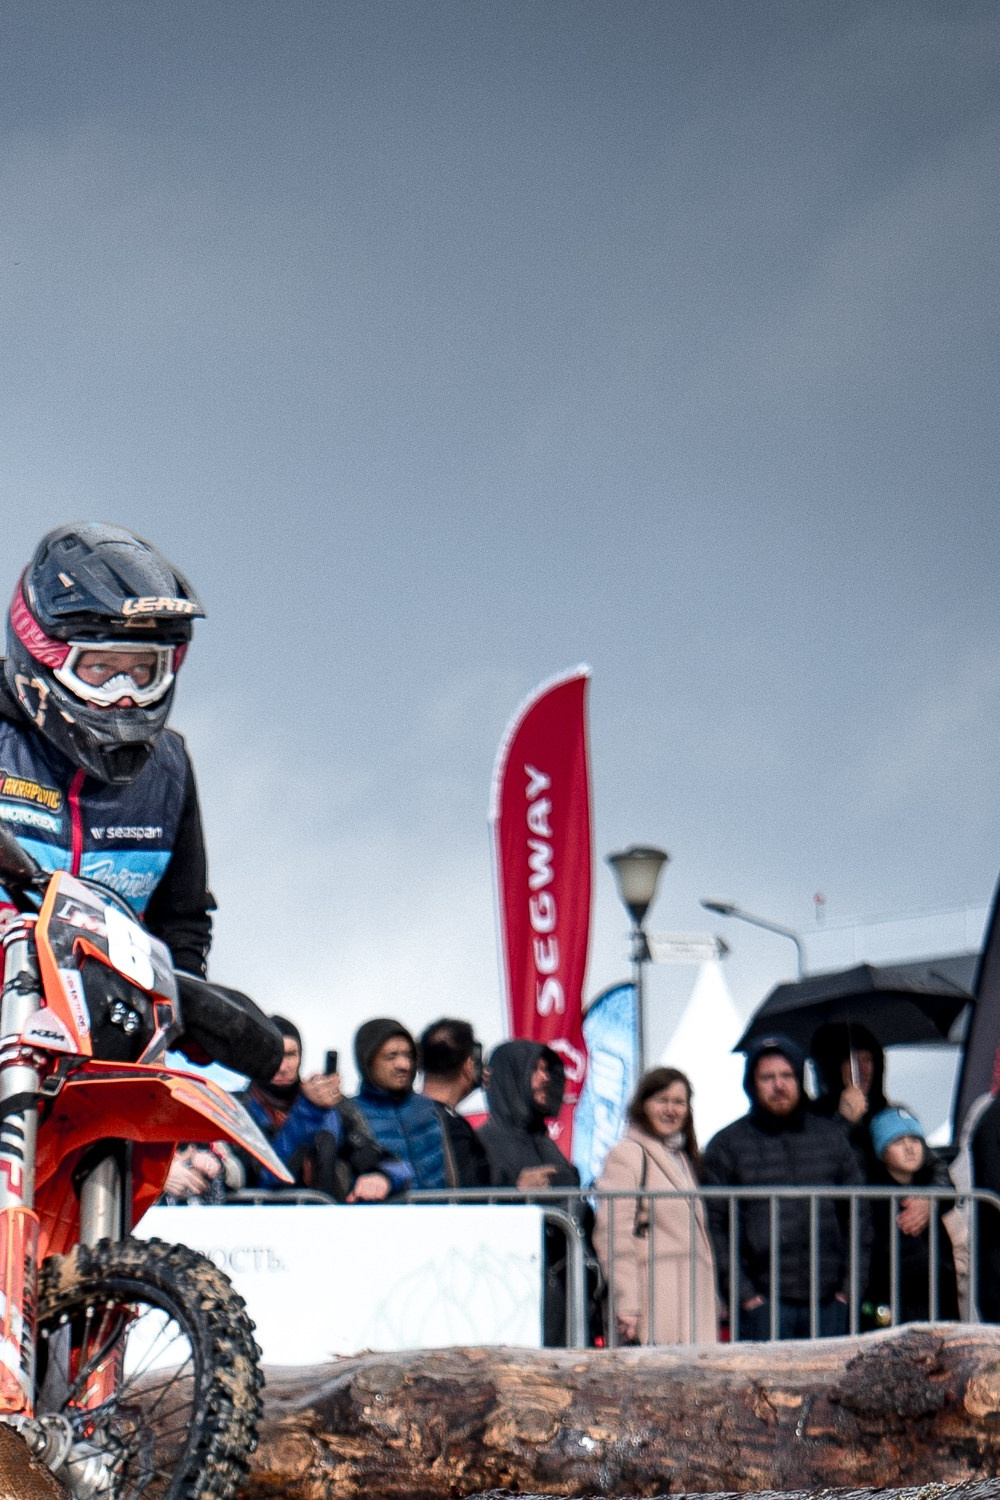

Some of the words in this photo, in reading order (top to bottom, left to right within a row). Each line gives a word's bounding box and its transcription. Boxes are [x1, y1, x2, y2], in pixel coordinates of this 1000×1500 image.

[122, 596, 198, 616] LEATT
[524, 763, 566, 1017] SEGWAY
[30, 1029, 65, 1042] KTM
